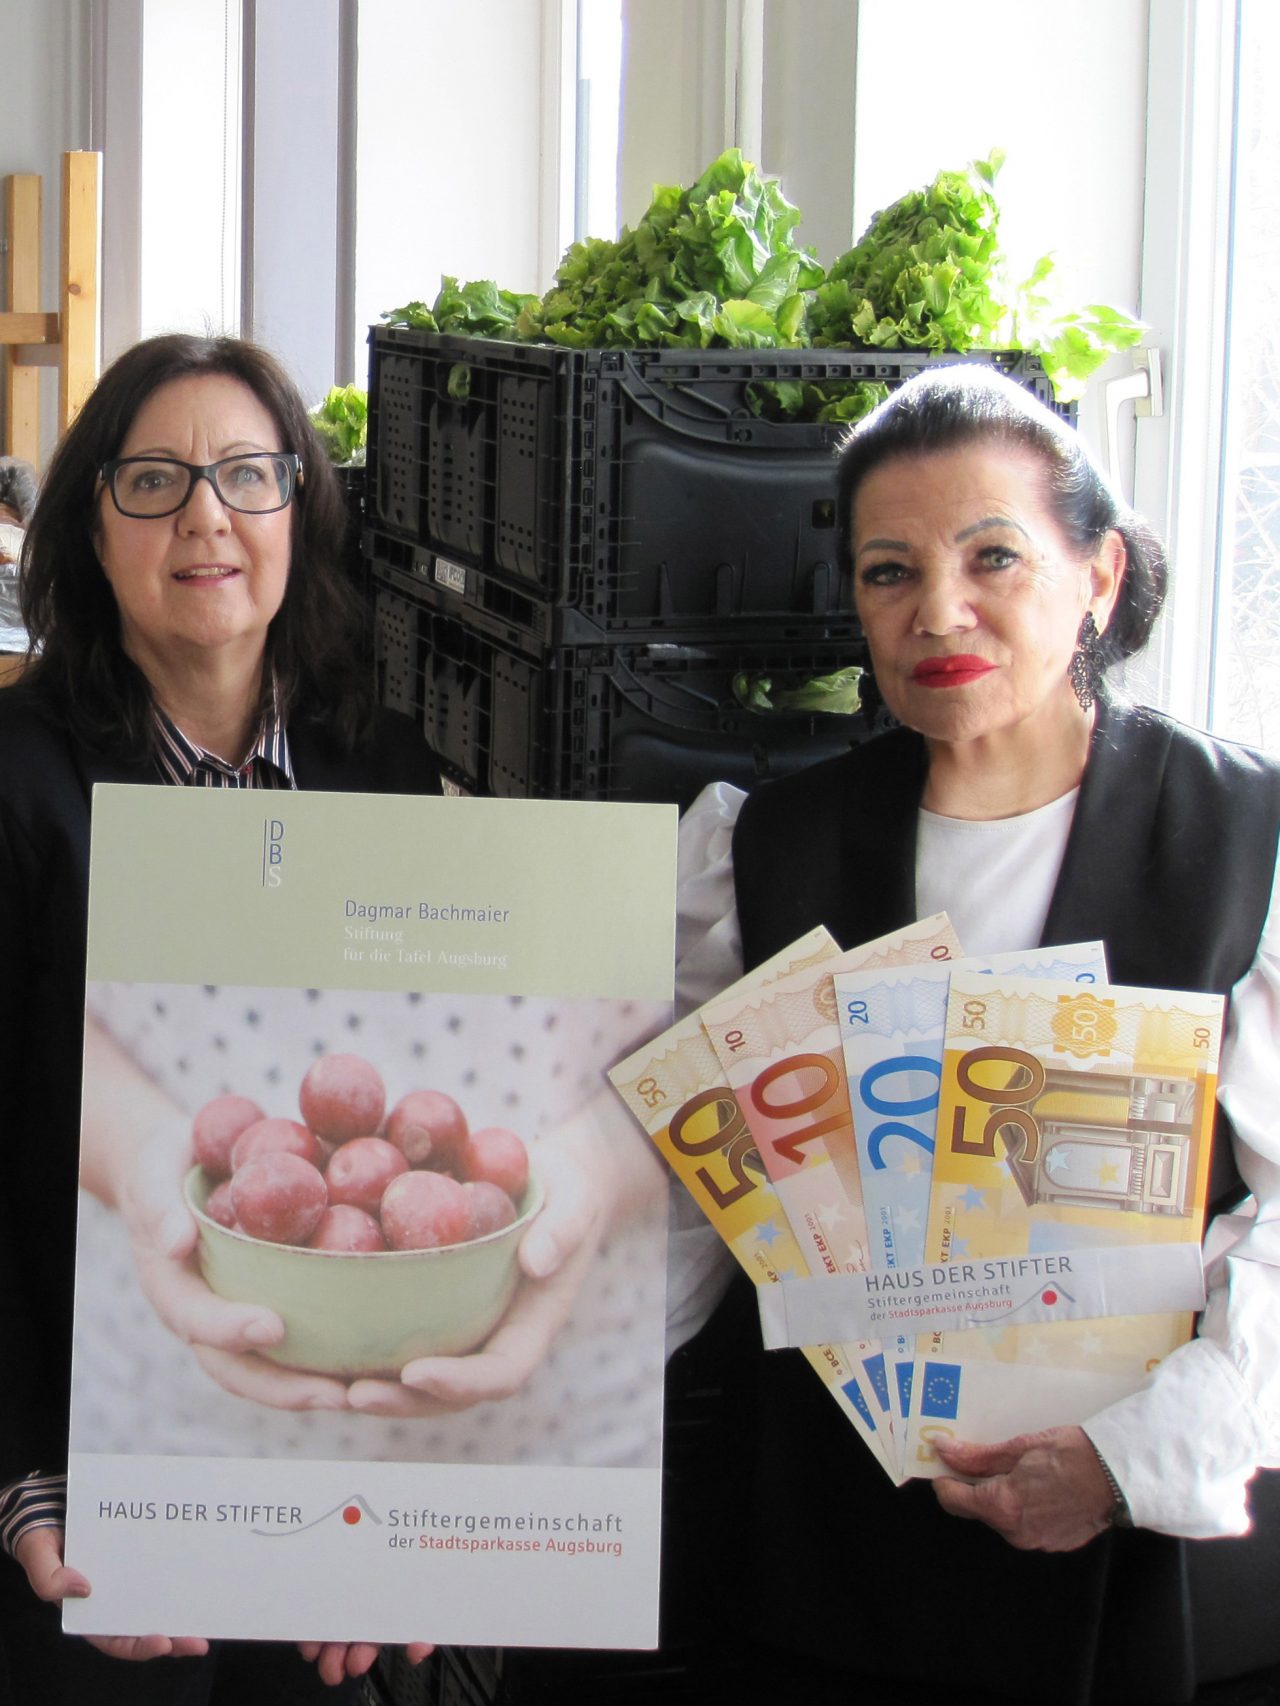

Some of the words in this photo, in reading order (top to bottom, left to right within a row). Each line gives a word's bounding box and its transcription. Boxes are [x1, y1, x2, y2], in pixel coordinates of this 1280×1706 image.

[345, 900, 412, 922] Dagmar
[419, 902, 509, 922] Bachmaier
[344, 926, 403, 944] Stiftung
[370, 948, 391, 962] die
[398, 949, 431, 964] Tafel
[437, 951, 508, 969] Augsburg
[847, 1000, 869, 1025] 20
[963, 1000, 987, 1030] 50
[1072, 1008, 1098, 1041] 50
[725, 1030, 746, 1053] 10
[1193, 1027, 1211, 1049] 50
[637, 1077, 666, 1108] 50
[751, 1053, 853, 1165] 10
[951, 1046, 1046, 1164] 50
[669, 1086, 758, 1210] 50
[866, 1270, 924, 1293] HAUS
[932, 1265, 976, 1285] DER
[983, 1256, 1072, 1280] STIFTER
[868, 1284, 1011, 1309] Stiftergemeinschaft
[870, 1312, 887, 1321] der
[888, 1304, 963, 1319] Stadtsparkasse
[965, 1299, 1013, 1312] Augsburg
[99, 1501, 156, 1520] HAUS
[165, 1503, 208, 1521] DER
[216, 1504, 302, 1524] STIFTER
[388, 1509, 623, 1533] Stiftergemeinschaft
[388, 1534, 415, 1548] der
[419, 1534, 541, 1553] Stadtsparkasse
[545, 1538, 623, 1556] Augsburg
